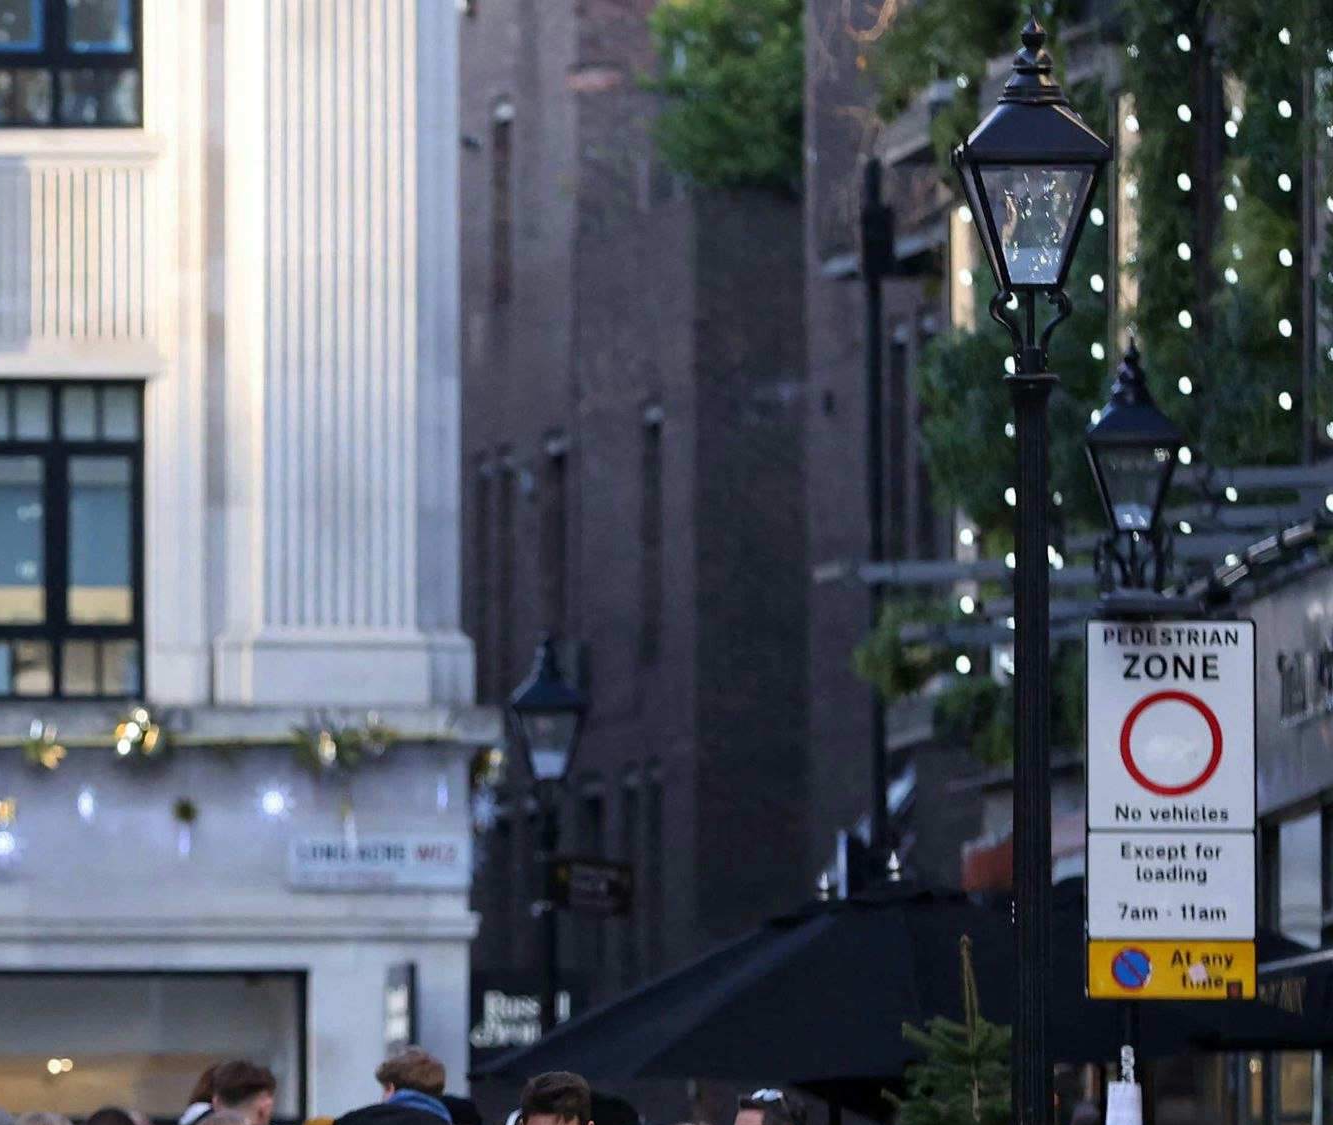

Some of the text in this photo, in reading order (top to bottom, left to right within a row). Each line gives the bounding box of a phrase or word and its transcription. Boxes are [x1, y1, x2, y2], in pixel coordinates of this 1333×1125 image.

[1103, 626, 1239, 647] PEDESTRIAN
[1122, 653, 1220, 681] ZONE
[1115, 804, 1229, 823] No vehicles
[1120, 842, 1222, 863] Except for
[1136, 865, 1208, 886] loading
[1119, 903, 1159, 921] 7am
[1181, 903, 1227, 921] 11am
[1171, 950, 1233, 970] At any
